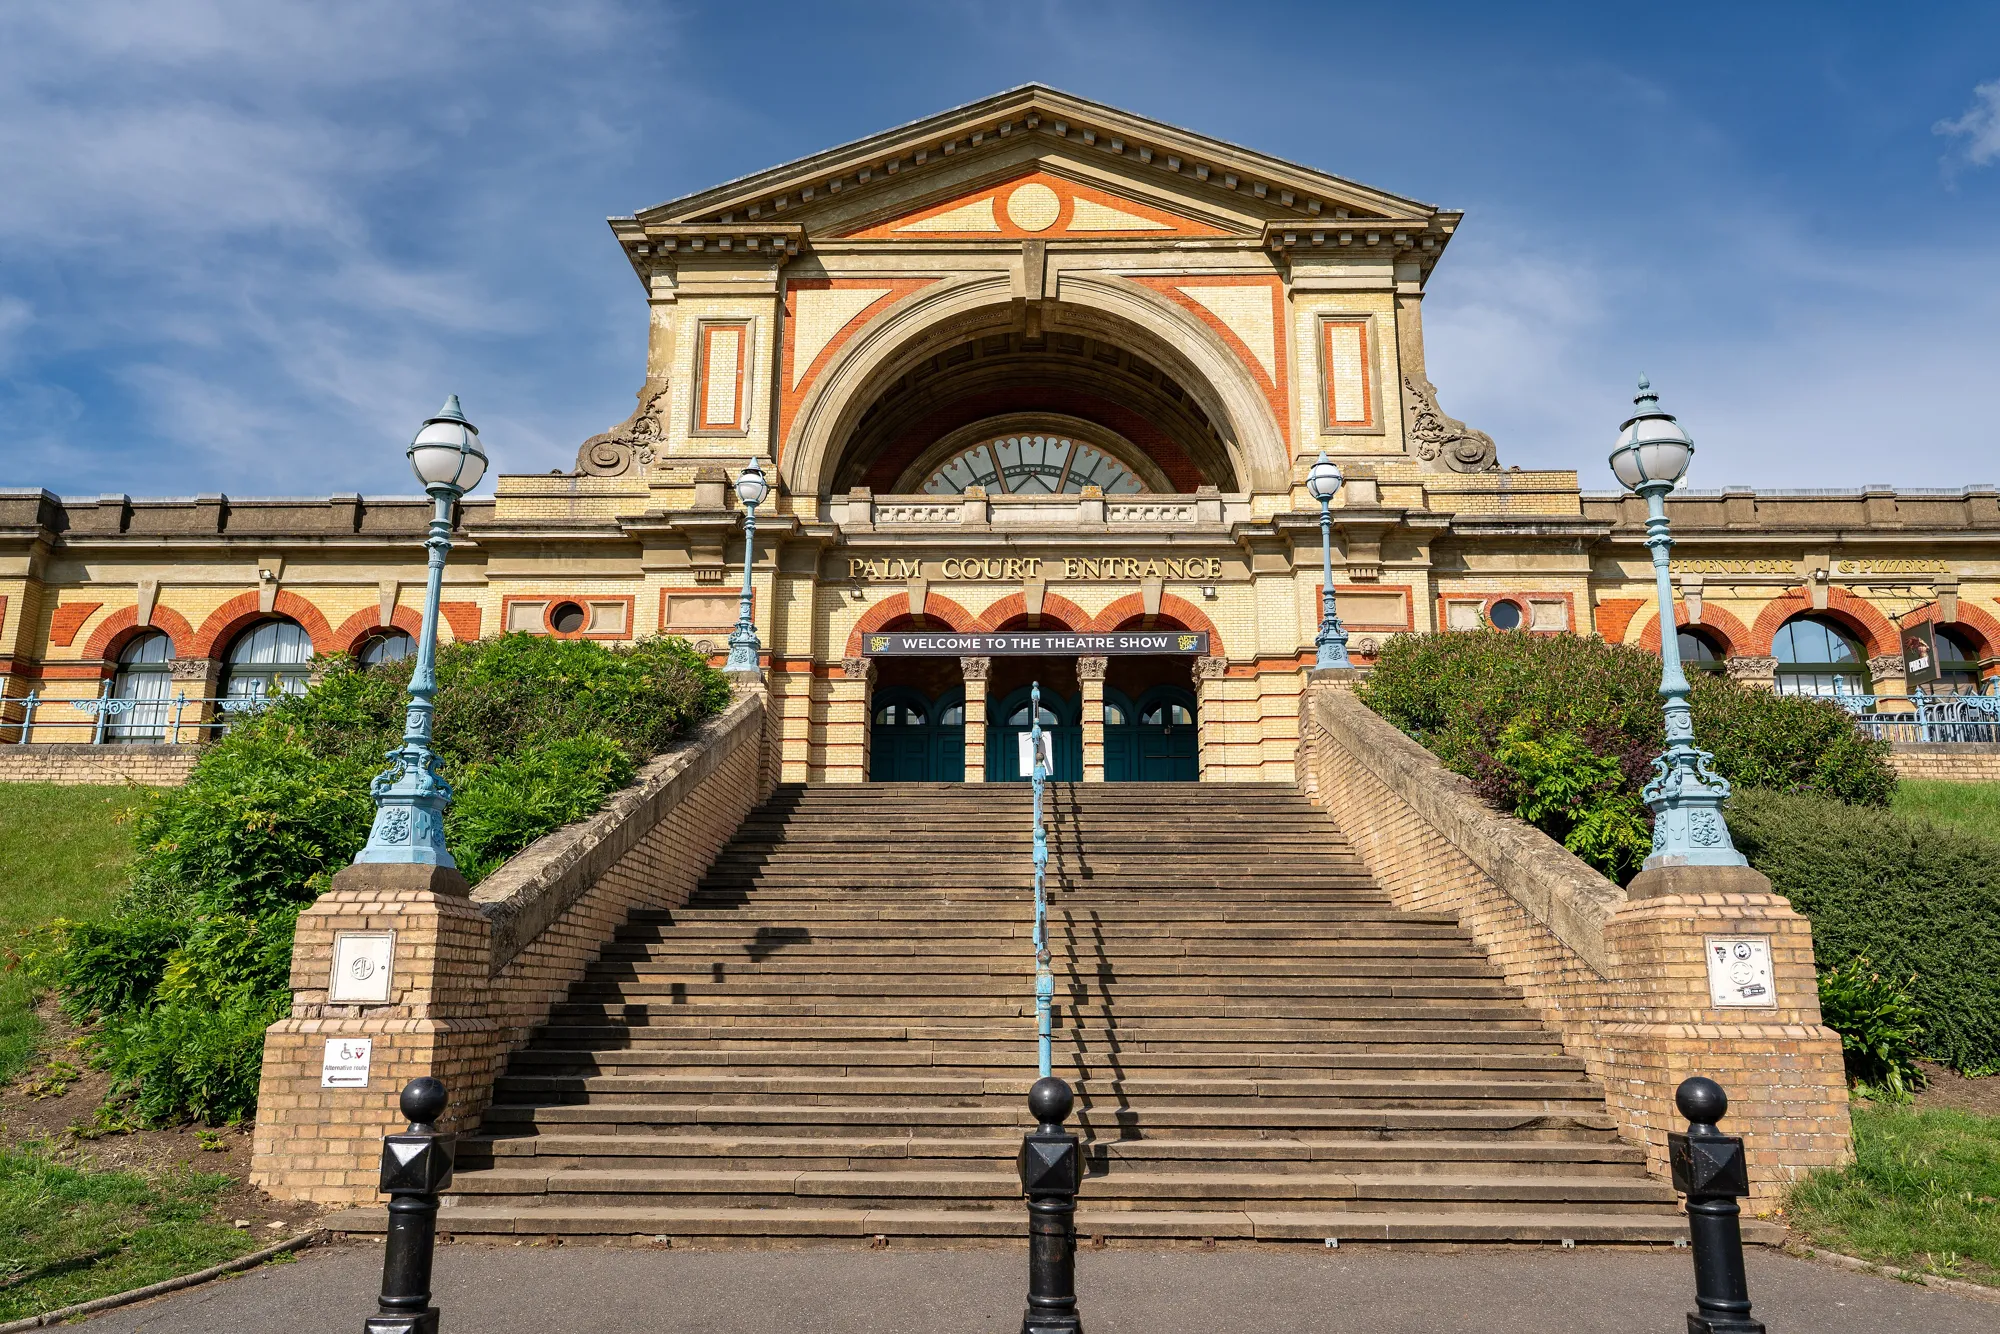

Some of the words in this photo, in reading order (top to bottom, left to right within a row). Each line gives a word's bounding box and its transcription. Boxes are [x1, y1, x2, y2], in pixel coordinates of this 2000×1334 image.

[847, 557, 924, 578] PALM
[941, 557, 1043, 579] COURT
[1062, 557, 1223, 579] ENTRANCE
[1669, 560, 1752, 573] PHOENIX
[1754, 560, 1796, 573] BAR
[1837, 560, 1855, 573] &
[1858, 560, 1950, 573] PIZZERIA
[902, 638, 980, 649] WELCOME
[990, 638, 1006, 649] TO
[1010, 638, 1041, 649] THE
[1045, 637, 1115, 649] THEATRE
[1119, 636, 1168, 648] SHOW
